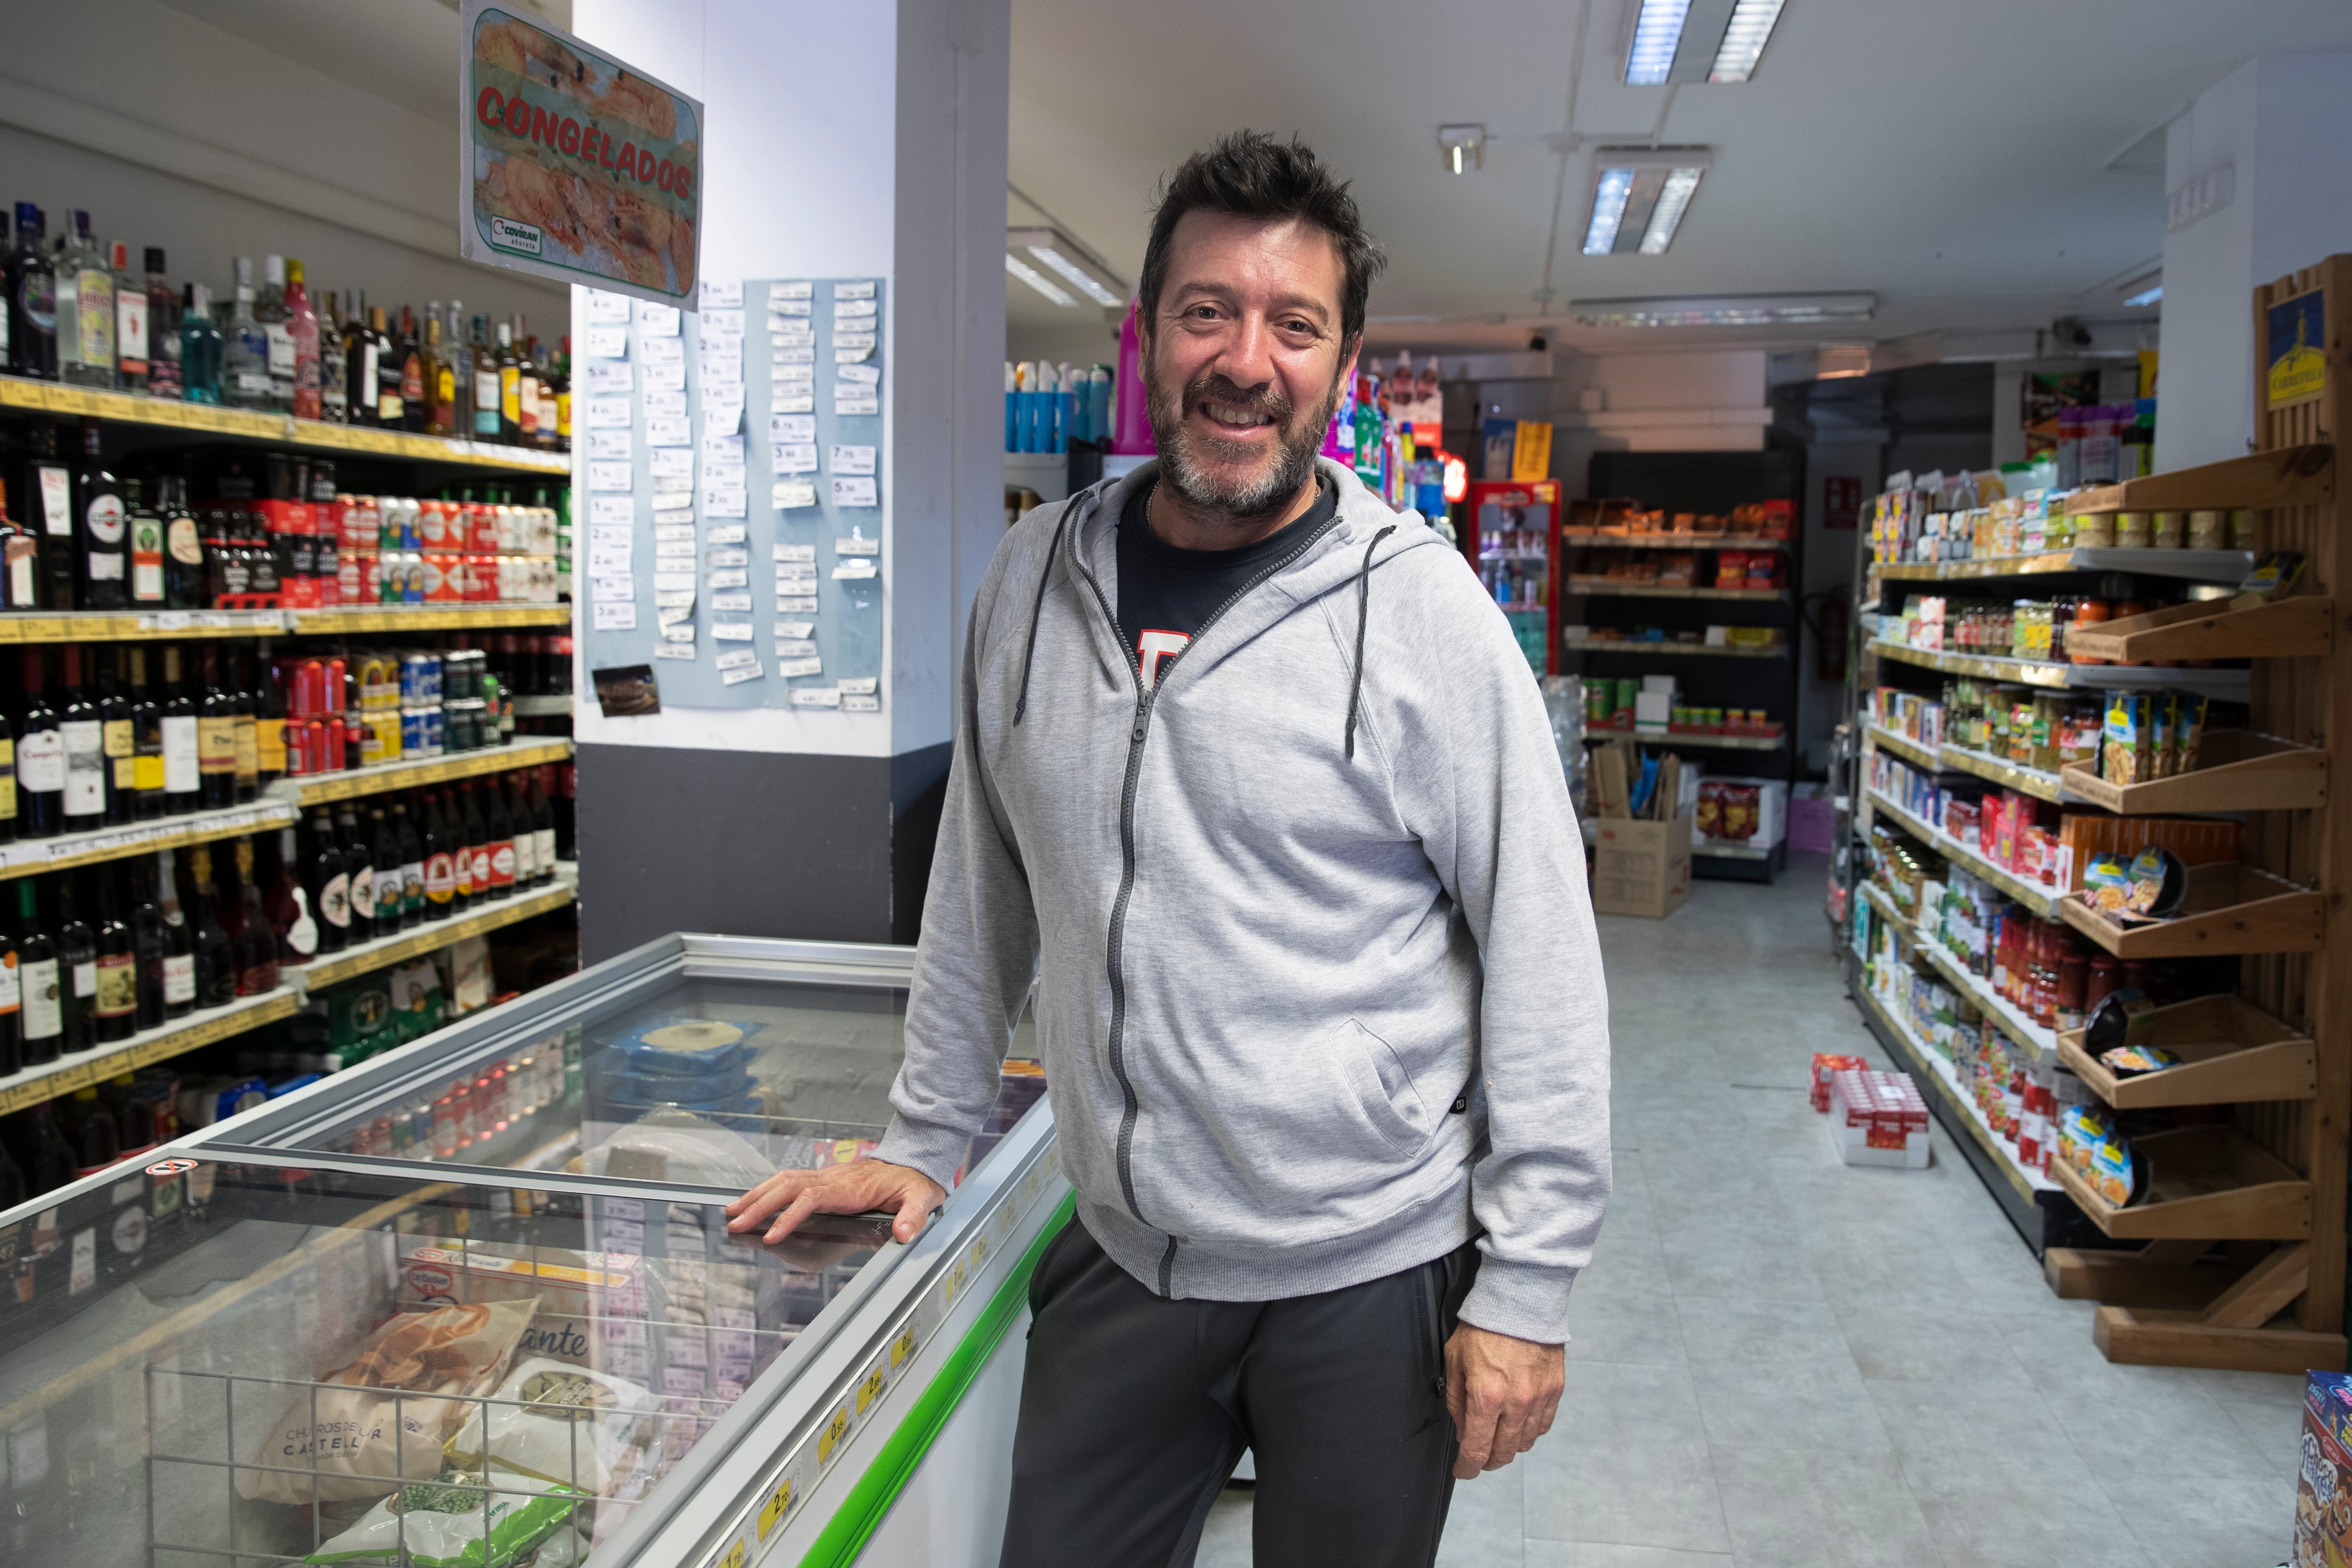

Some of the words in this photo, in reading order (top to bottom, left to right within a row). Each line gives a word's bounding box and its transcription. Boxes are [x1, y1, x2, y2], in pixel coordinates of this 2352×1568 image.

[477, 87, 690, 198] CONGELADOS
[505, 226, 538, 242] COVIRAN
[283, 1428, 381, 1456] CASTELLR
